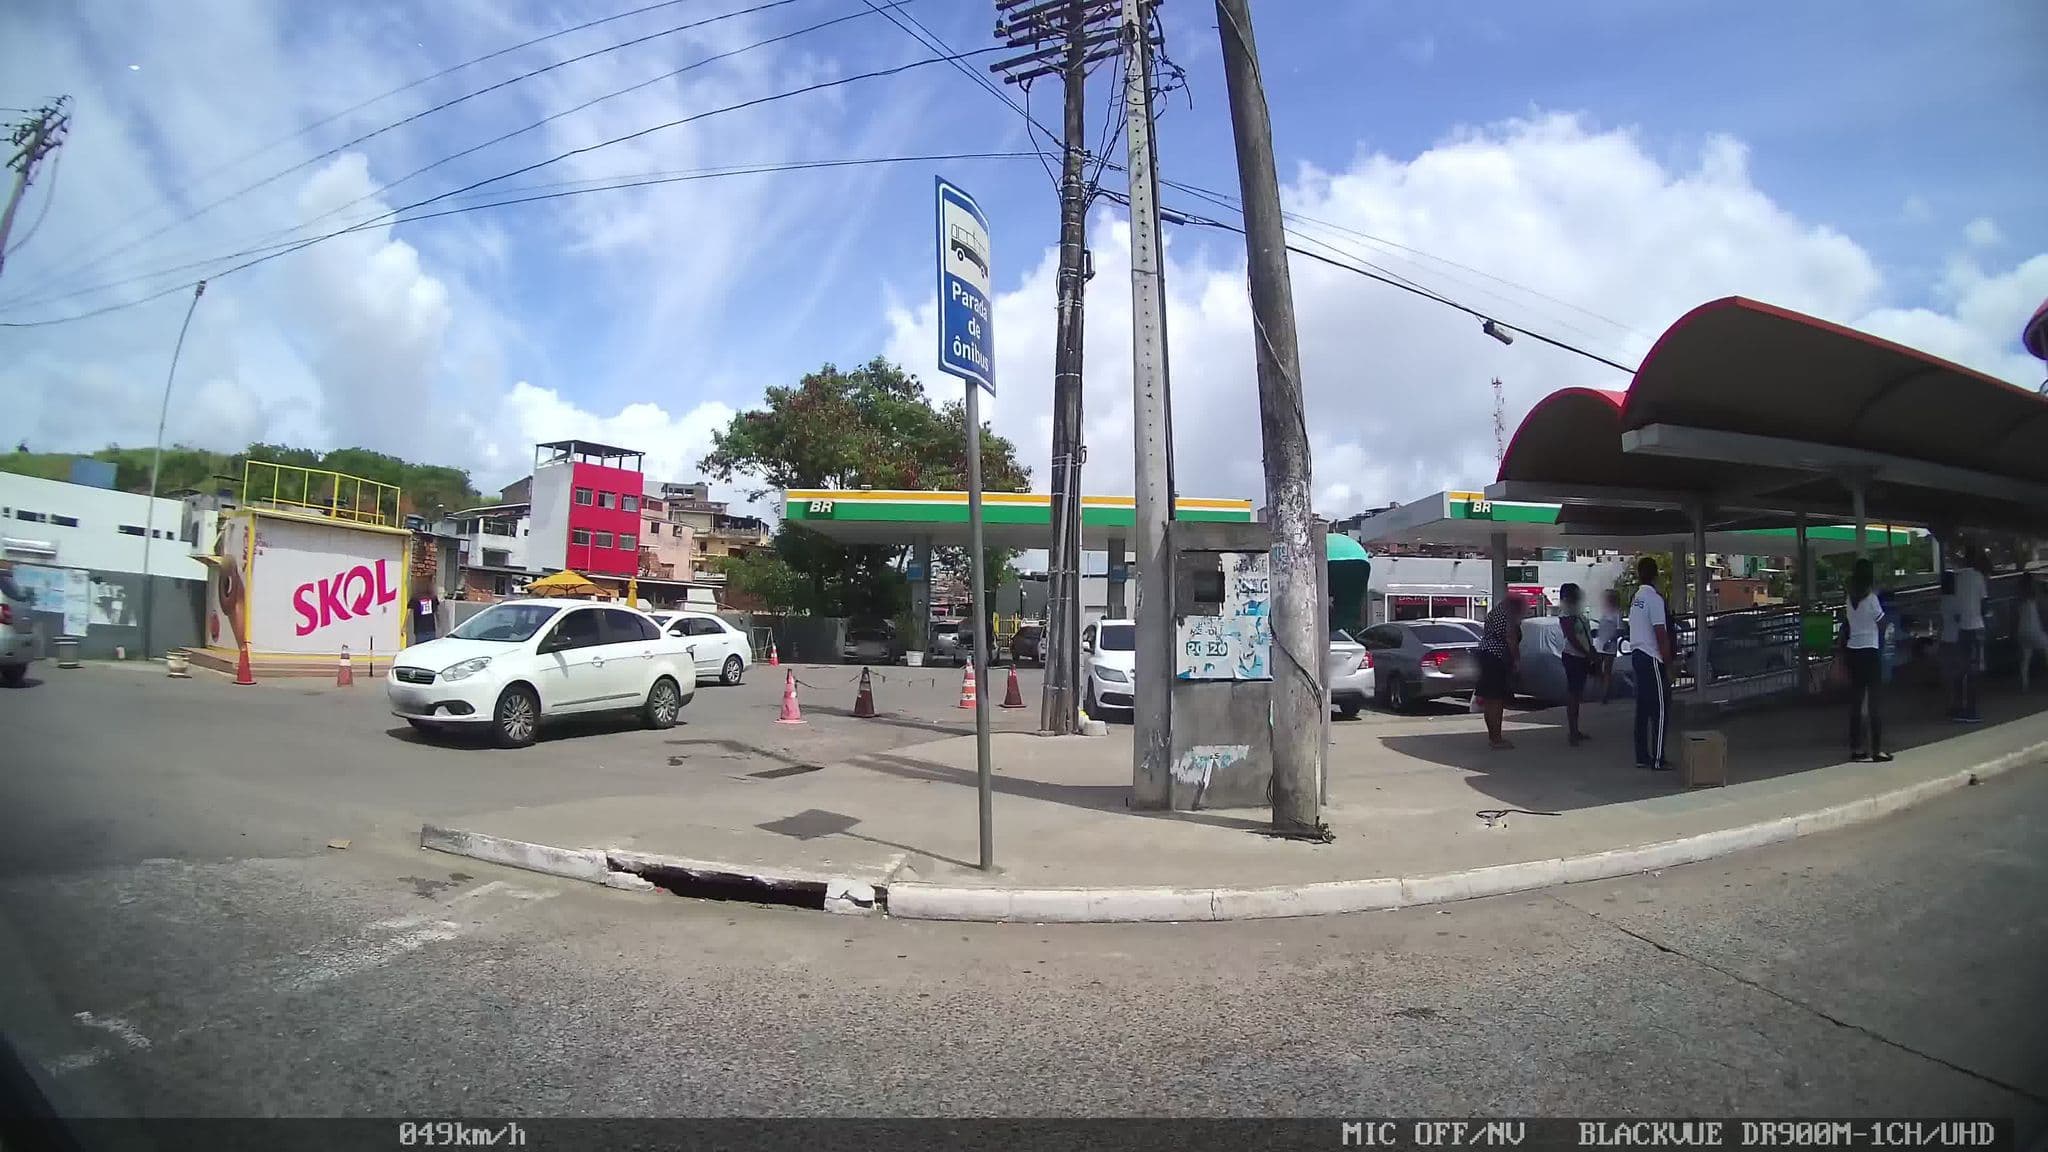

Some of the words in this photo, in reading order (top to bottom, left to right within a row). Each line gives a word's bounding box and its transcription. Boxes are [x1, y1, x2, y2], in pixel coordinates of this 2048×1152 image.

[952, 281, 988, 320] Parada
[967, 318, 981, 340] de
[953, 335, 990, 373] ônibus
[809, 501, 832, 513] BR
[1472, 502, 1491, 513] BR
[293, 558, 397, 636] SKOL
